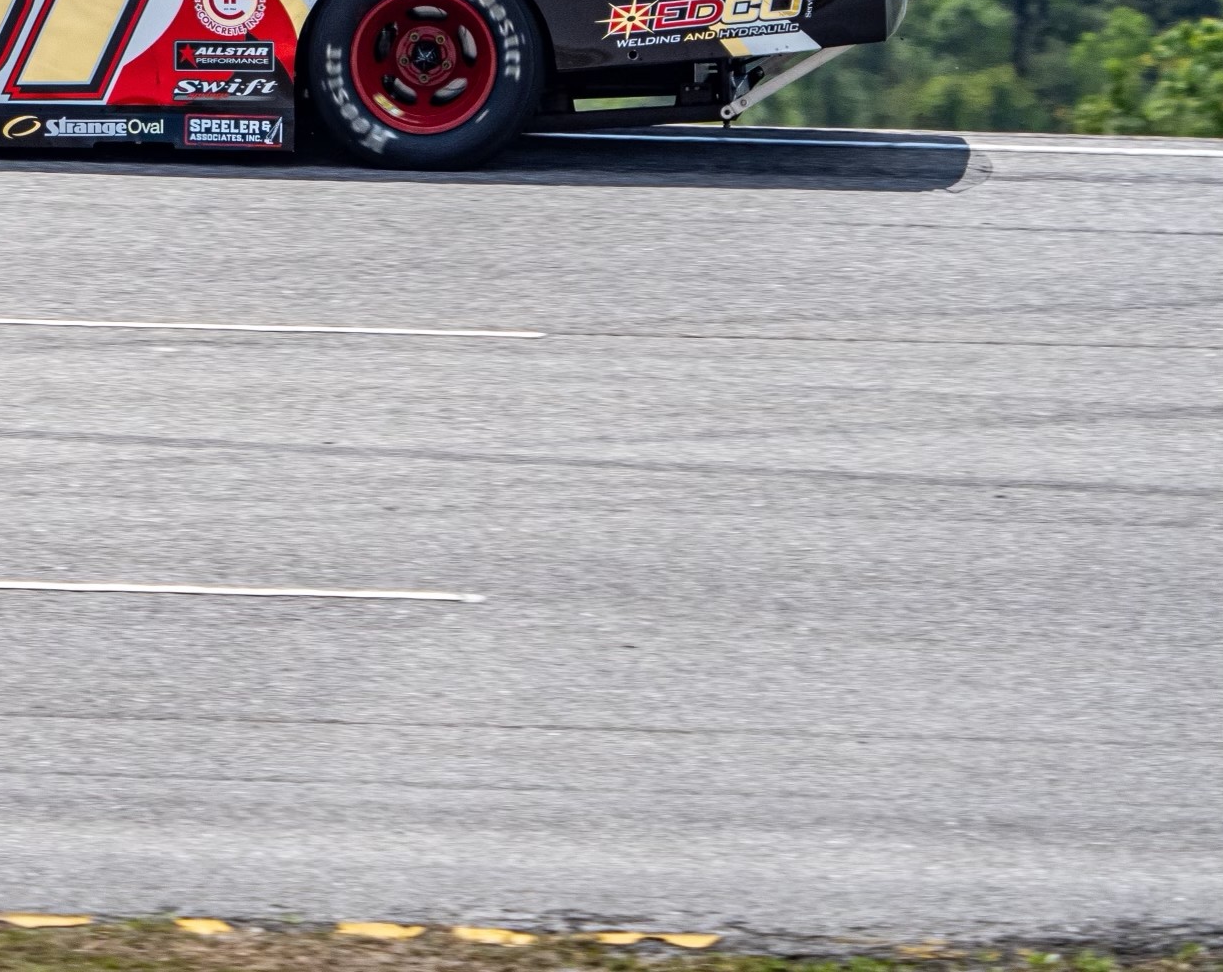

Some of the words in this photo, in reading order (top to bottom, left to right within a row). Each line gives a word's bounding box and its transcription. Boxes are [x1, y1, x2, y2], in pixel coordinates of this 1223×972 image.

[617, 34, 681, 48] WELDING
[683, 30, 717, 42] AND
[719, 22, 800, 38] HYDRAULIC
[195, 46, 270, 56] ALLSTAR
[195, 57, 270, 65] PERFORMANCE
[189, 119, 260, 134] SPEELER
[261, 120, 272, 133] &
[189, 133, 244, 143] ASSOCIATES,
[245, 134, 263, 142] INC.
